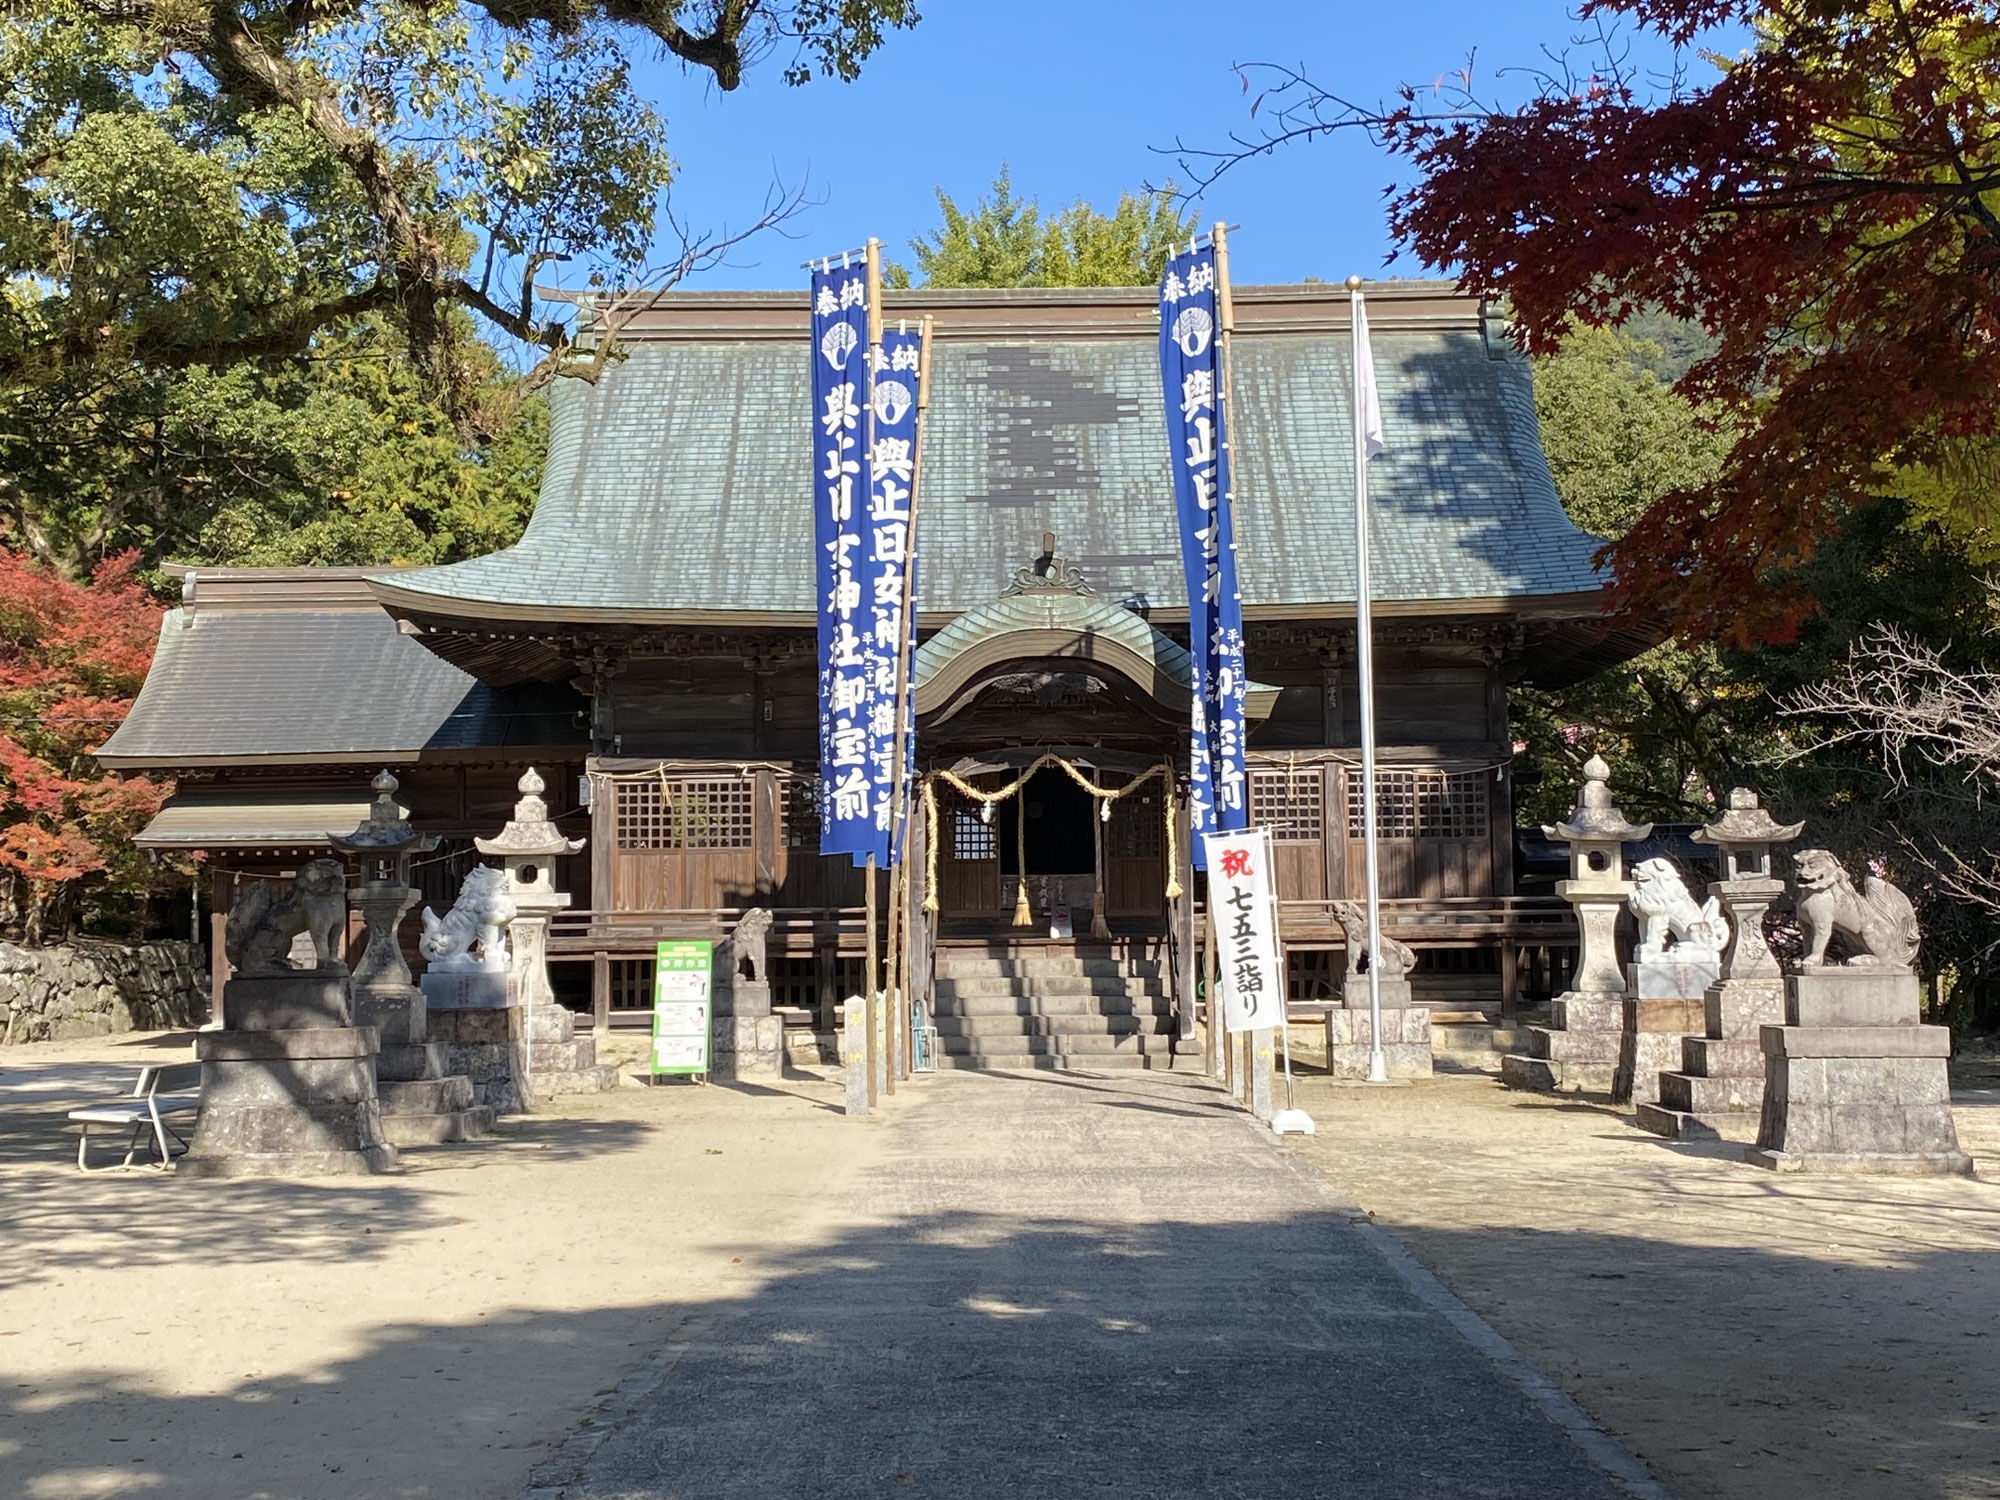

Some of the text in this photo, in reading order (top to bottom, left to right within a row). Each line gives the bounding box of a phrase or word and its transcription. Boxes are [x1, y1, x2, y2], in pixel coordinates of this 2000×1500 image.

[814, 277, 865, 317] 奉納
[1163, 262, 1214, 304] 奉納
[867, 344, 920, 372] 奉納
[1219, 849, 1263, 1018] 祝 七五三詣り
